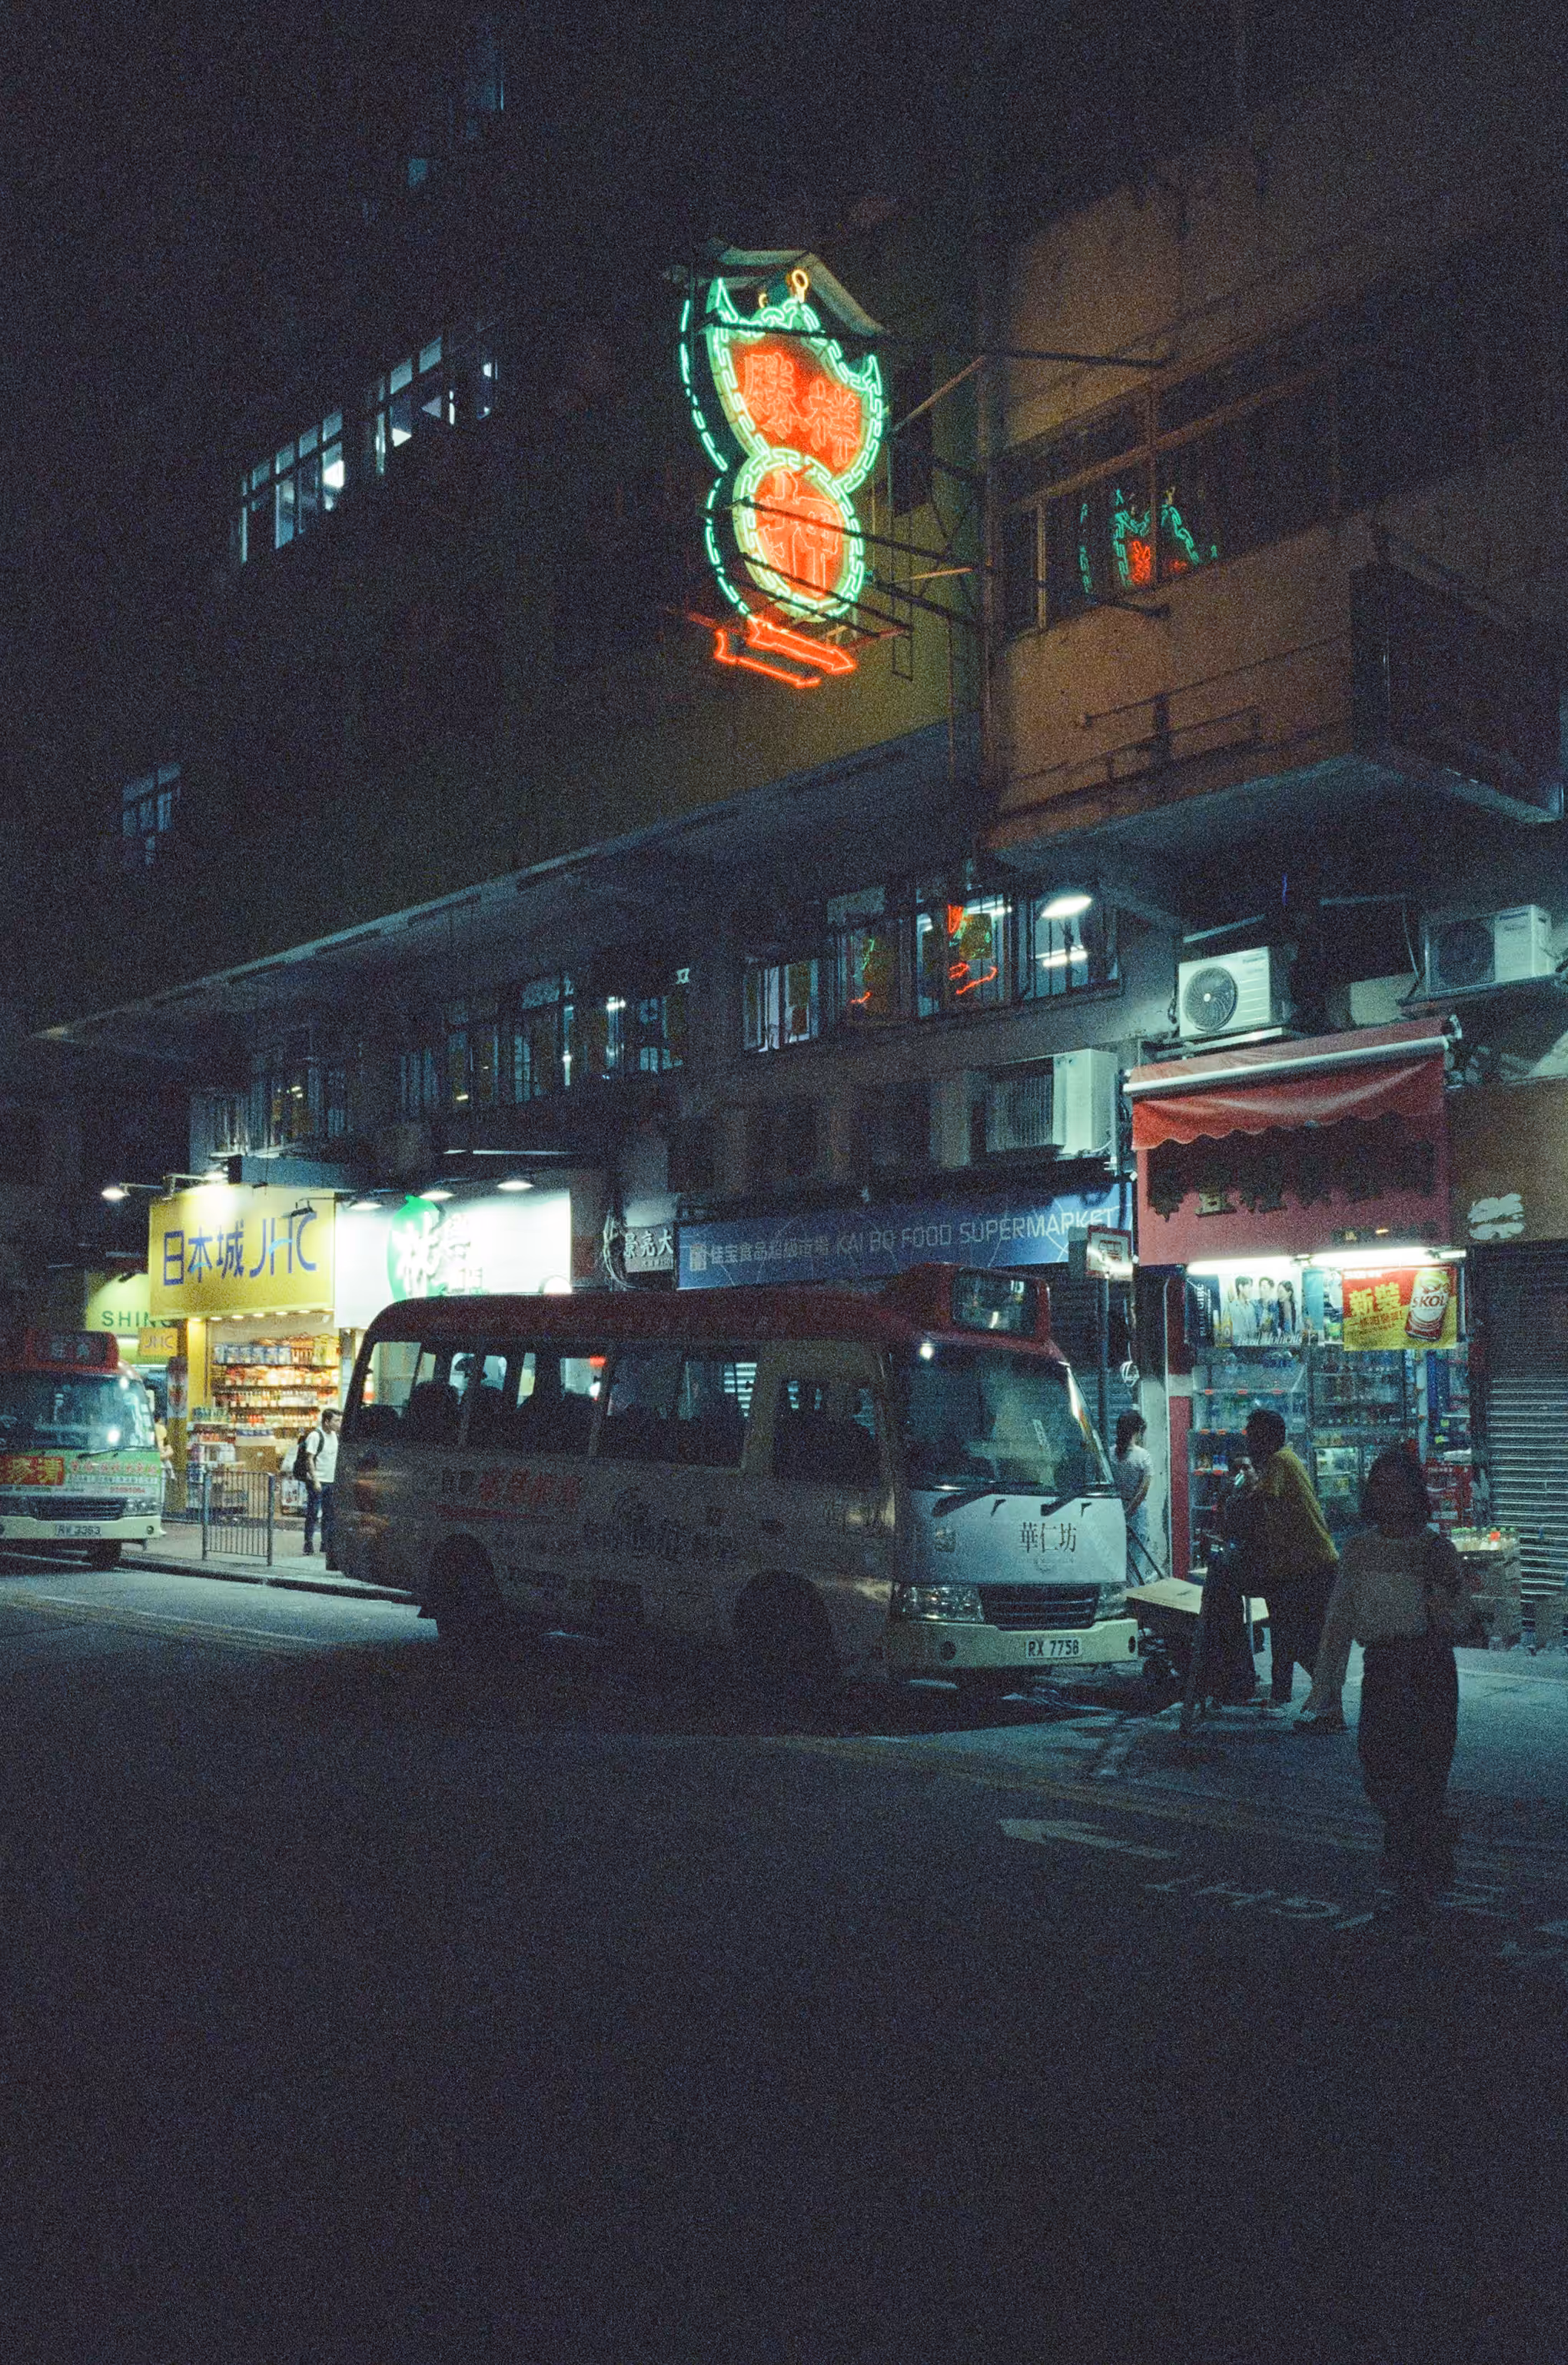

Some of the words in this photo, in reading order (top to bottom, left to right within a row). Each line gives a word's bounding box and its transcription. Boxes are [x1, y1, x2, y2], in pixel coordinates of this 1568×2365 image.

[902, 1225, 952, 1247] FOOD
[960, 1208, 1118, 1242] SUPERMARKET
[164, 1218, 244, 1286] 日本城
[249, 1212, 317, 1278] JHC
[1350, 1282, 1401, 1316] 新裝
[1412, 1295, 1445, 1308] SKOL
[1028, 1640, 1044, 1656] RX
[1049, 1639, 1079, 1656] 7758
